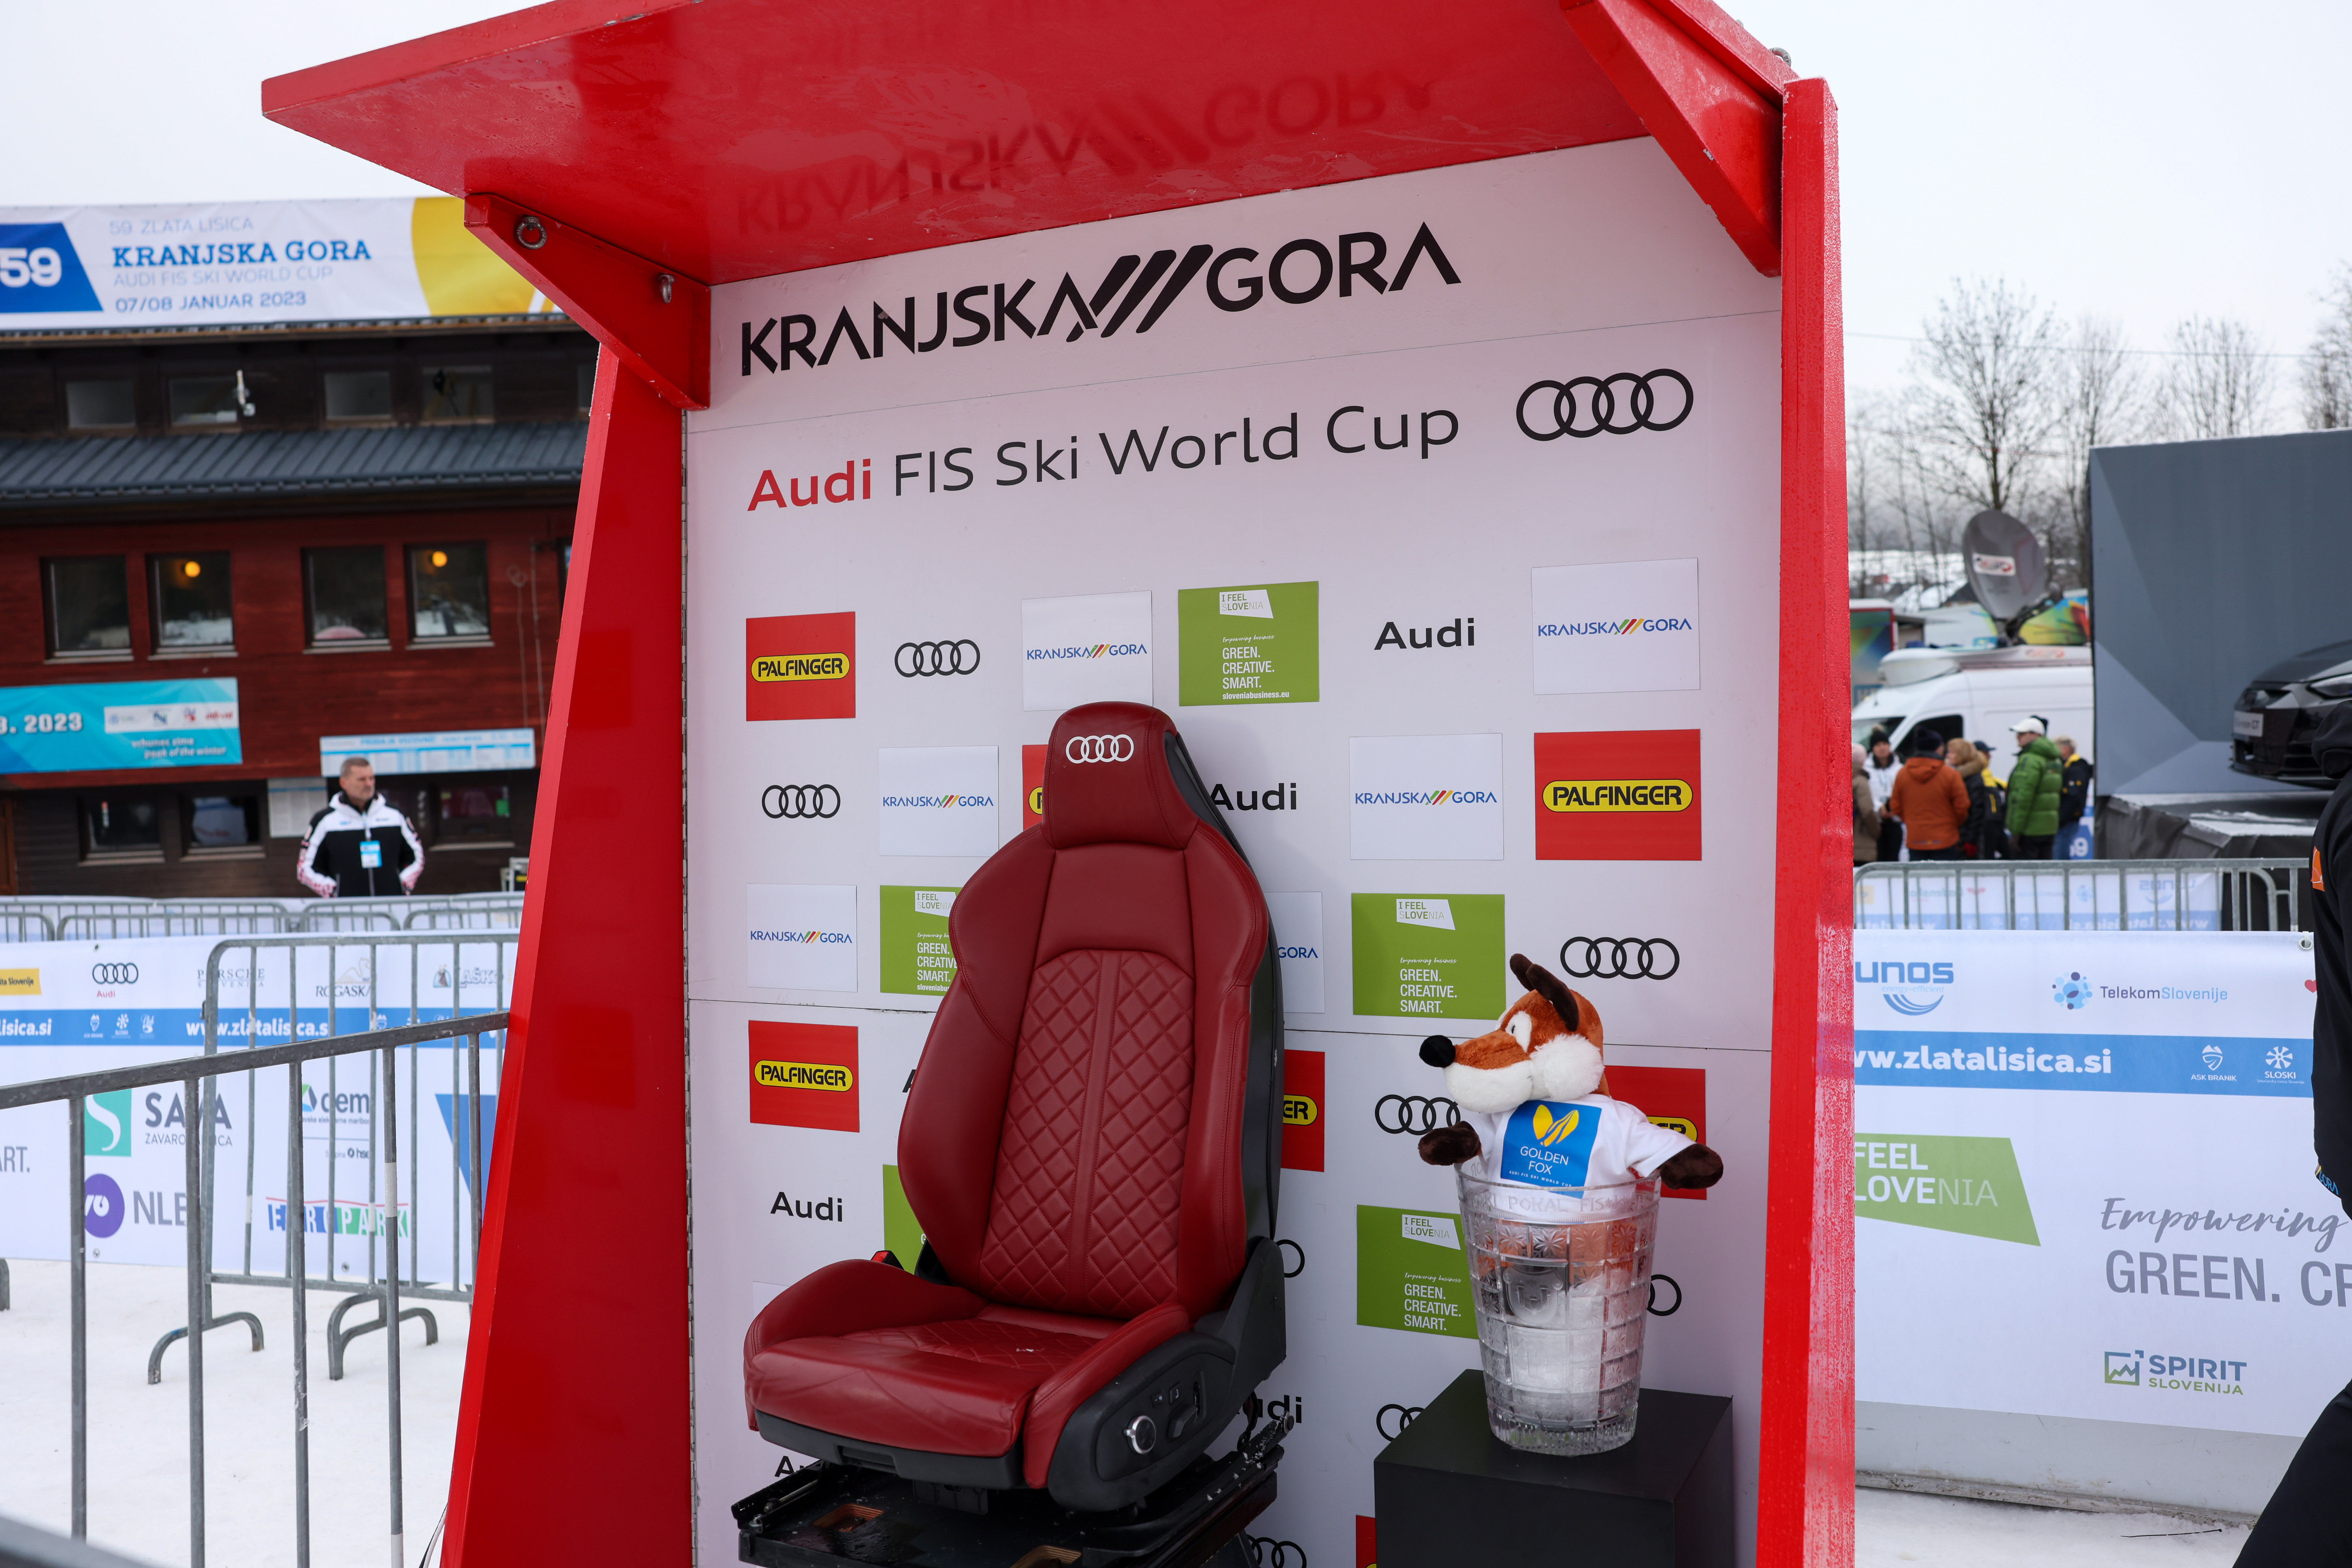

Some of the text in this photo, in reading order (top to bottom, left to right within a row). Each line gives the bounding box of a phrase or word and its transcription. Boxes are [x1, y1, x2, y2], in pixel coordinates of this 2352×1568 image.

[110, 216, 254, 235] 59 ZLATA LISICA
[112, 240, 371, 267] KRANJSKA GORA
[0, 247, 62, 288] 59
[114, 265, 332, 287] AUDI FIS SKI WORLD CUP
[116, 291, 307, 312] 07/08 JANUAR 2023
[741, 221, 1461, 376] KRANJSKA GORA
[748, 405, 1459, 511] Audi FIS Ski World Cup
[1227, 593, 1247, 601] FEEL
[1222, 601, 1263, 611] SLOVENIA
[1374, 618, 1474, 650] Audi
[1538, 618, 1692, 637] KRANJSKA GORA
[1027, 643, 1147, 660] KRANJSKA GORA
[1223, 646, 1260, 659] GREEN.
[758, 658, 843, 677] PALFINGER
[1223, 661, 1274, 674] CREATIVE.
[1223, 676, 1261, 689] SMART.
[1223, 691, 1289, 699] sloveniabusiness.eu
[23, 712, 83, 733] 2023
[883, 796, 994, 807] KRANJSKA GORA
[1209, 783, 1296, 810] Audi
[1355, 791, 1497, 804] KRANJSKA GORA
[1553, 786, 1682, 806] PALFINGER
[1405, 901, 1426, 910] FEEL
[1400, 911, 1444, 920] SLOVENIA
[751, 931, 852, 944] KRANJSKA GORA
[917, 942, 950, 954] GREEN.
[1278, 947, 1319, 959] GORA
[917, 970, 950, 982] SMART.
[1400, 969, 1442, 982] GREEN.
[96, 990, 116, 998] Audi
[1400, 984, 1457, 998] CREATIVE.
[1400, 1000, 1443, 1013] SMART.
[761, 1065, 846, 1087] PALFINGER
[145, 1092, 232, 1129] SAA
[0, 1146, 30, 1173] RT.
[1520, 1146, 1569, 1165] GOLDEN
[1529, 1161, 1553, 1175] FOX
[770, 1191, 842, 1222] Audi
[1411, 1218, 1432, 1227] FEEL
[2101, 1197, 2349, 1253] Empowering
[1405, 1227, 1450, 1238] SLOVENIA
[1405, 1273, 1437, 1283] Empowering
[2106, 1250, 2280, 1302] GREEN.
[1405, 1283, 1446, 1299] GREEN.
[1404, 1299, 1461, 1317] CREATIVE.
[1404, 1314, 1447, 1331] SMART.
[2149, 1355, 2247, 1382] SPIRIT
[2149, 1378, 2244, 1395] SLOVENIJA
